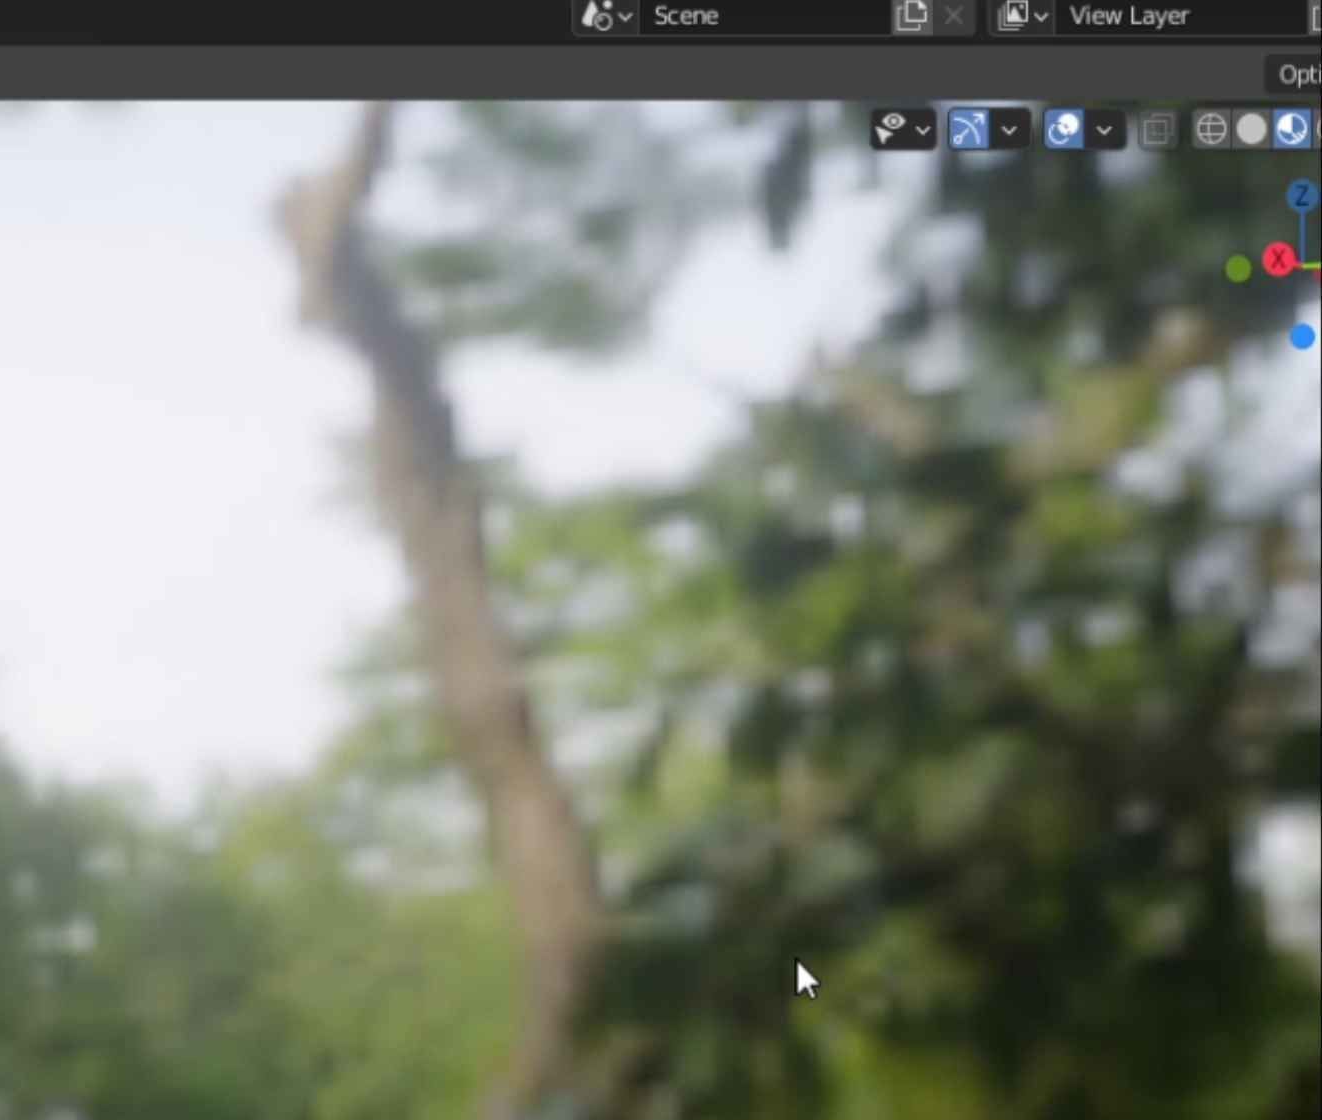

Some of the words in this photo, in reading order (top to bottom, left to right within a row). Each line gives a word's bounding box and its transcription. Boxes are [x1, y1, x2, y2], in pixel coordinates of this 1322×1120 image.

[656, 5, 719, 26] Scene
[1070, 5, 1122, 26] View
[1130, 6, 1190, 29] Layer
[1296, 184, 1310, 207] Z
[1271, 249, 1286, 270] X
